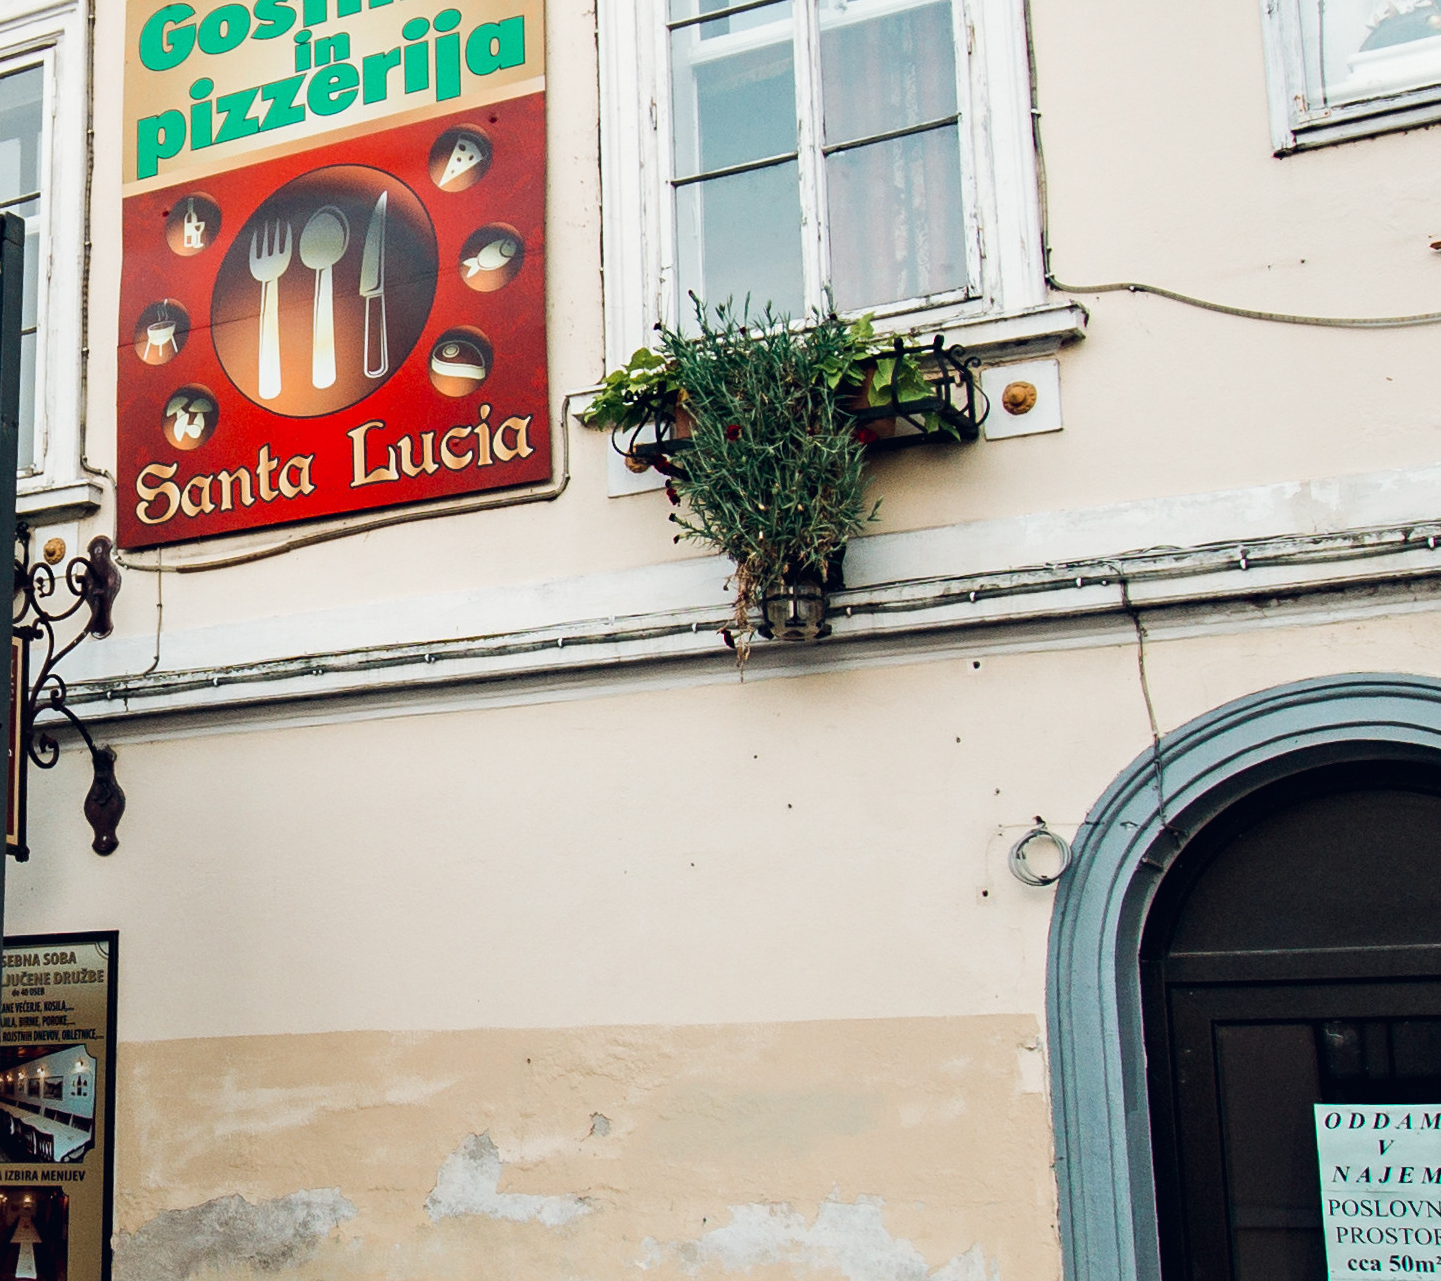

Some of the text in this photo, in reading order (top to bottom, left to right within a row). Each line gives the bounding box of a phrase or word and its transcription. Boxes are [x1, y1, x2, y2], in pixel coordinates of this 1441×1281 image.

[295, 29, 351, 73] in
[136, 8, 526, 180] pizzerija
[133, 403, 535, 525] Santa Lucia
[2, 951, 77, 968] SEBNA SOBA
[53, 967, 105, 984] DRUŽBE
[1377, 1139, 1395, 1157] V
[5, 1170, 39, 1181] IZBIRA
[41, 1170, 86, 1181] MENIJEV
[1347, 1257, 1382, 1273] cca
